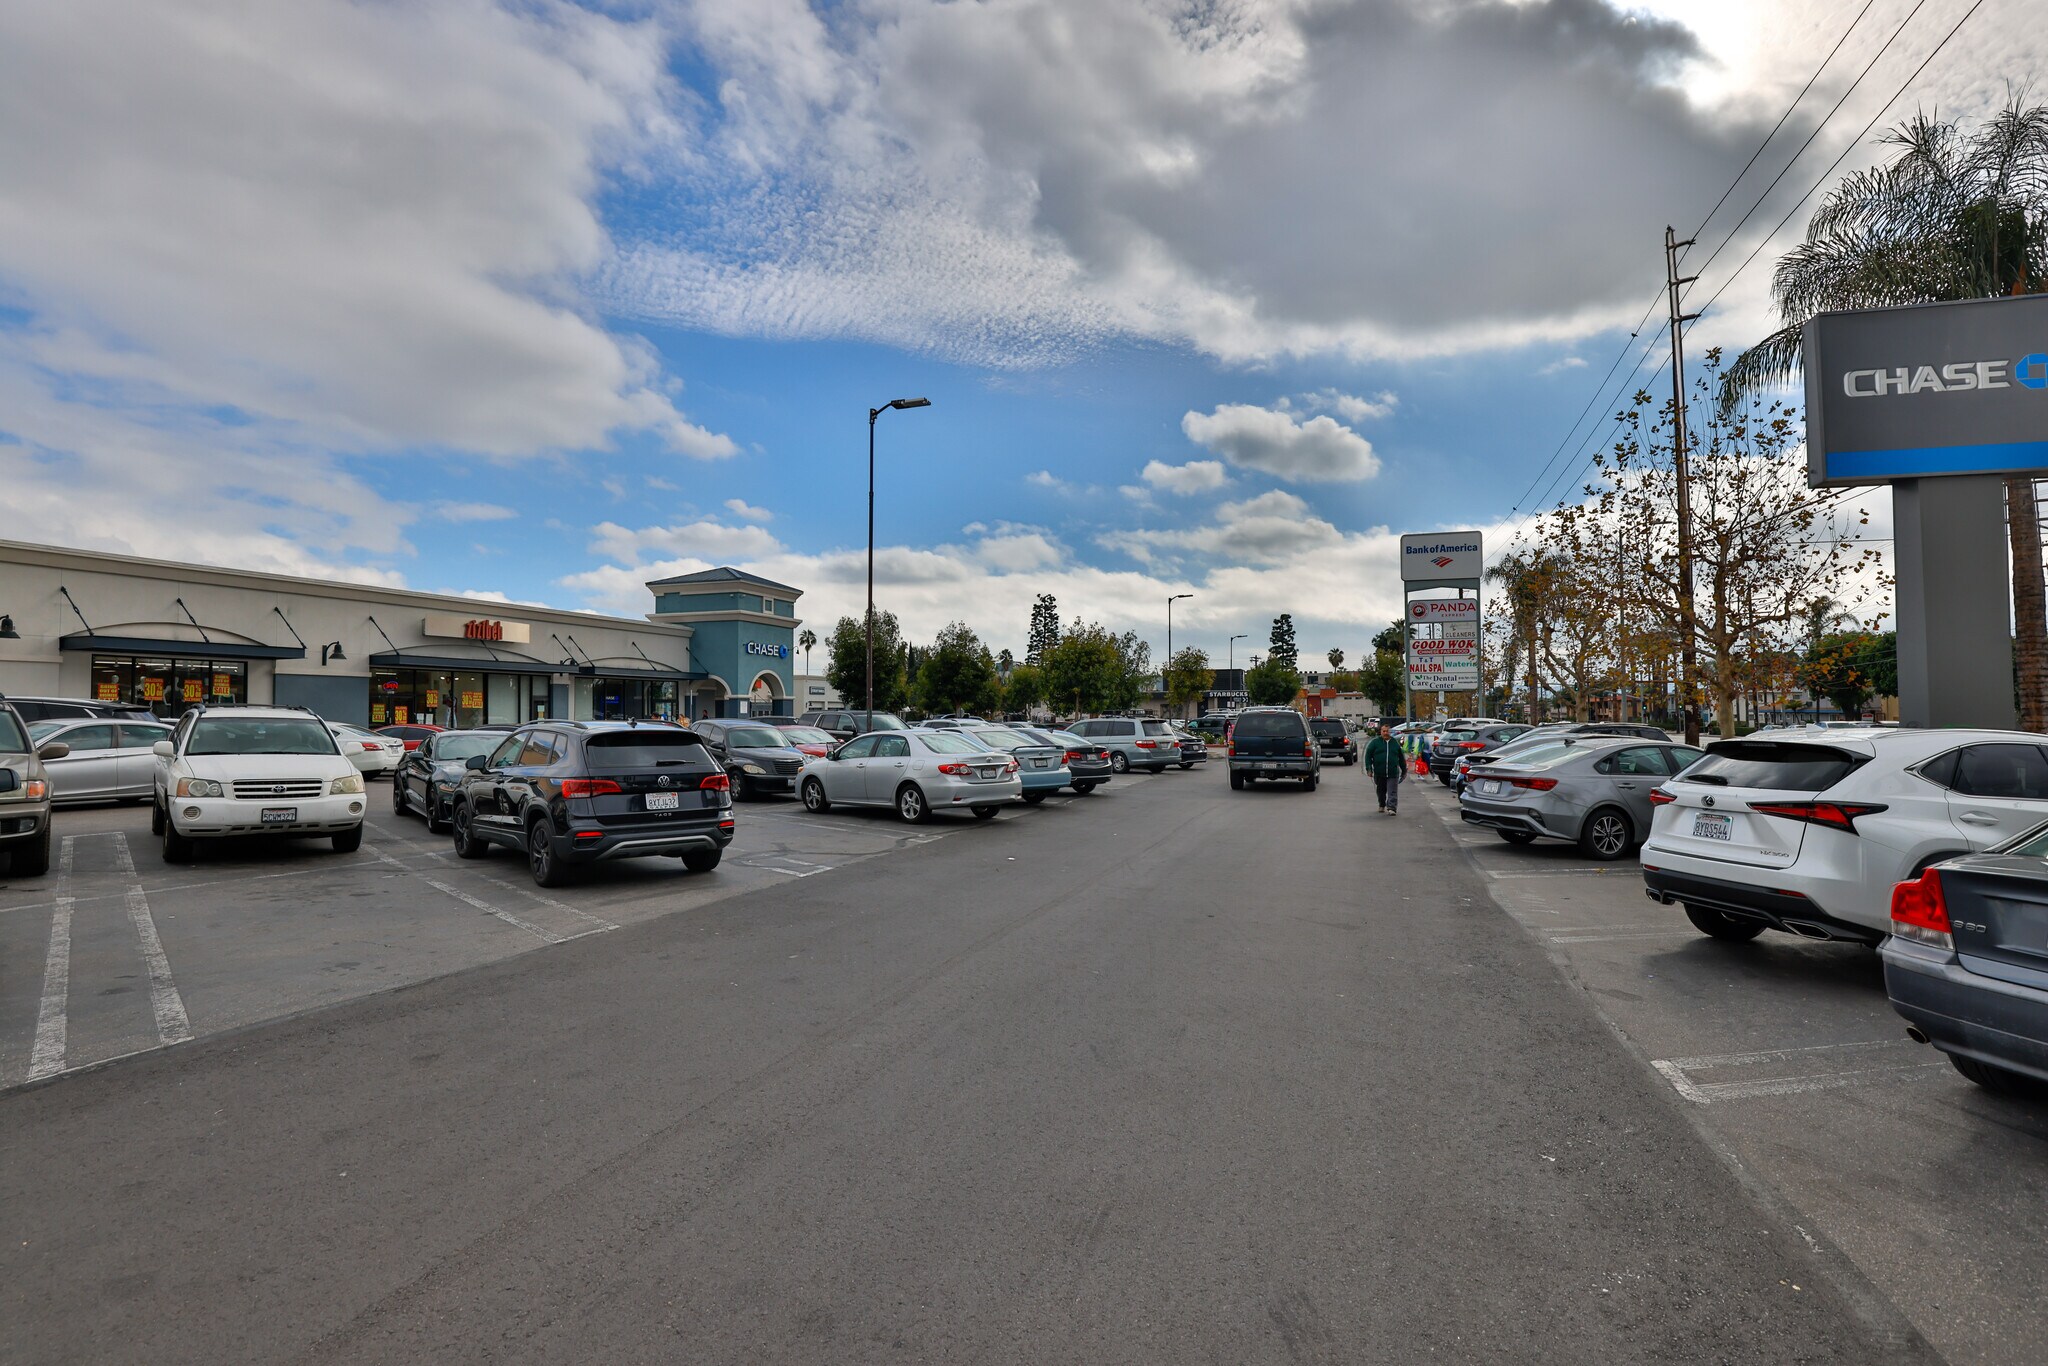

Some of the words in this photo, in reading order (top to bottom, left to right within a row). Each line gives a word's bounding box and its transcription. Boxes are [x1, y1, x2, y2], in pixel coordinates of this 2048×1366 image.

[1843, 360, 2011, 397] CHASE
[1406, 545, 1429, 554] Bank
[1429, 544, 1439, 553] of
[1439, 543, 1478, 552] America
[1430, 602, 1476, 612] PANDA
[746, 642, 779, 656] CHASE
[1412, 640, 1445, 649] GOOD
[1448, 639, 1475, 648] WOK
[1409, 664, 1427, 672] NAIL
[1428, 664, 1442, 672] SPA
